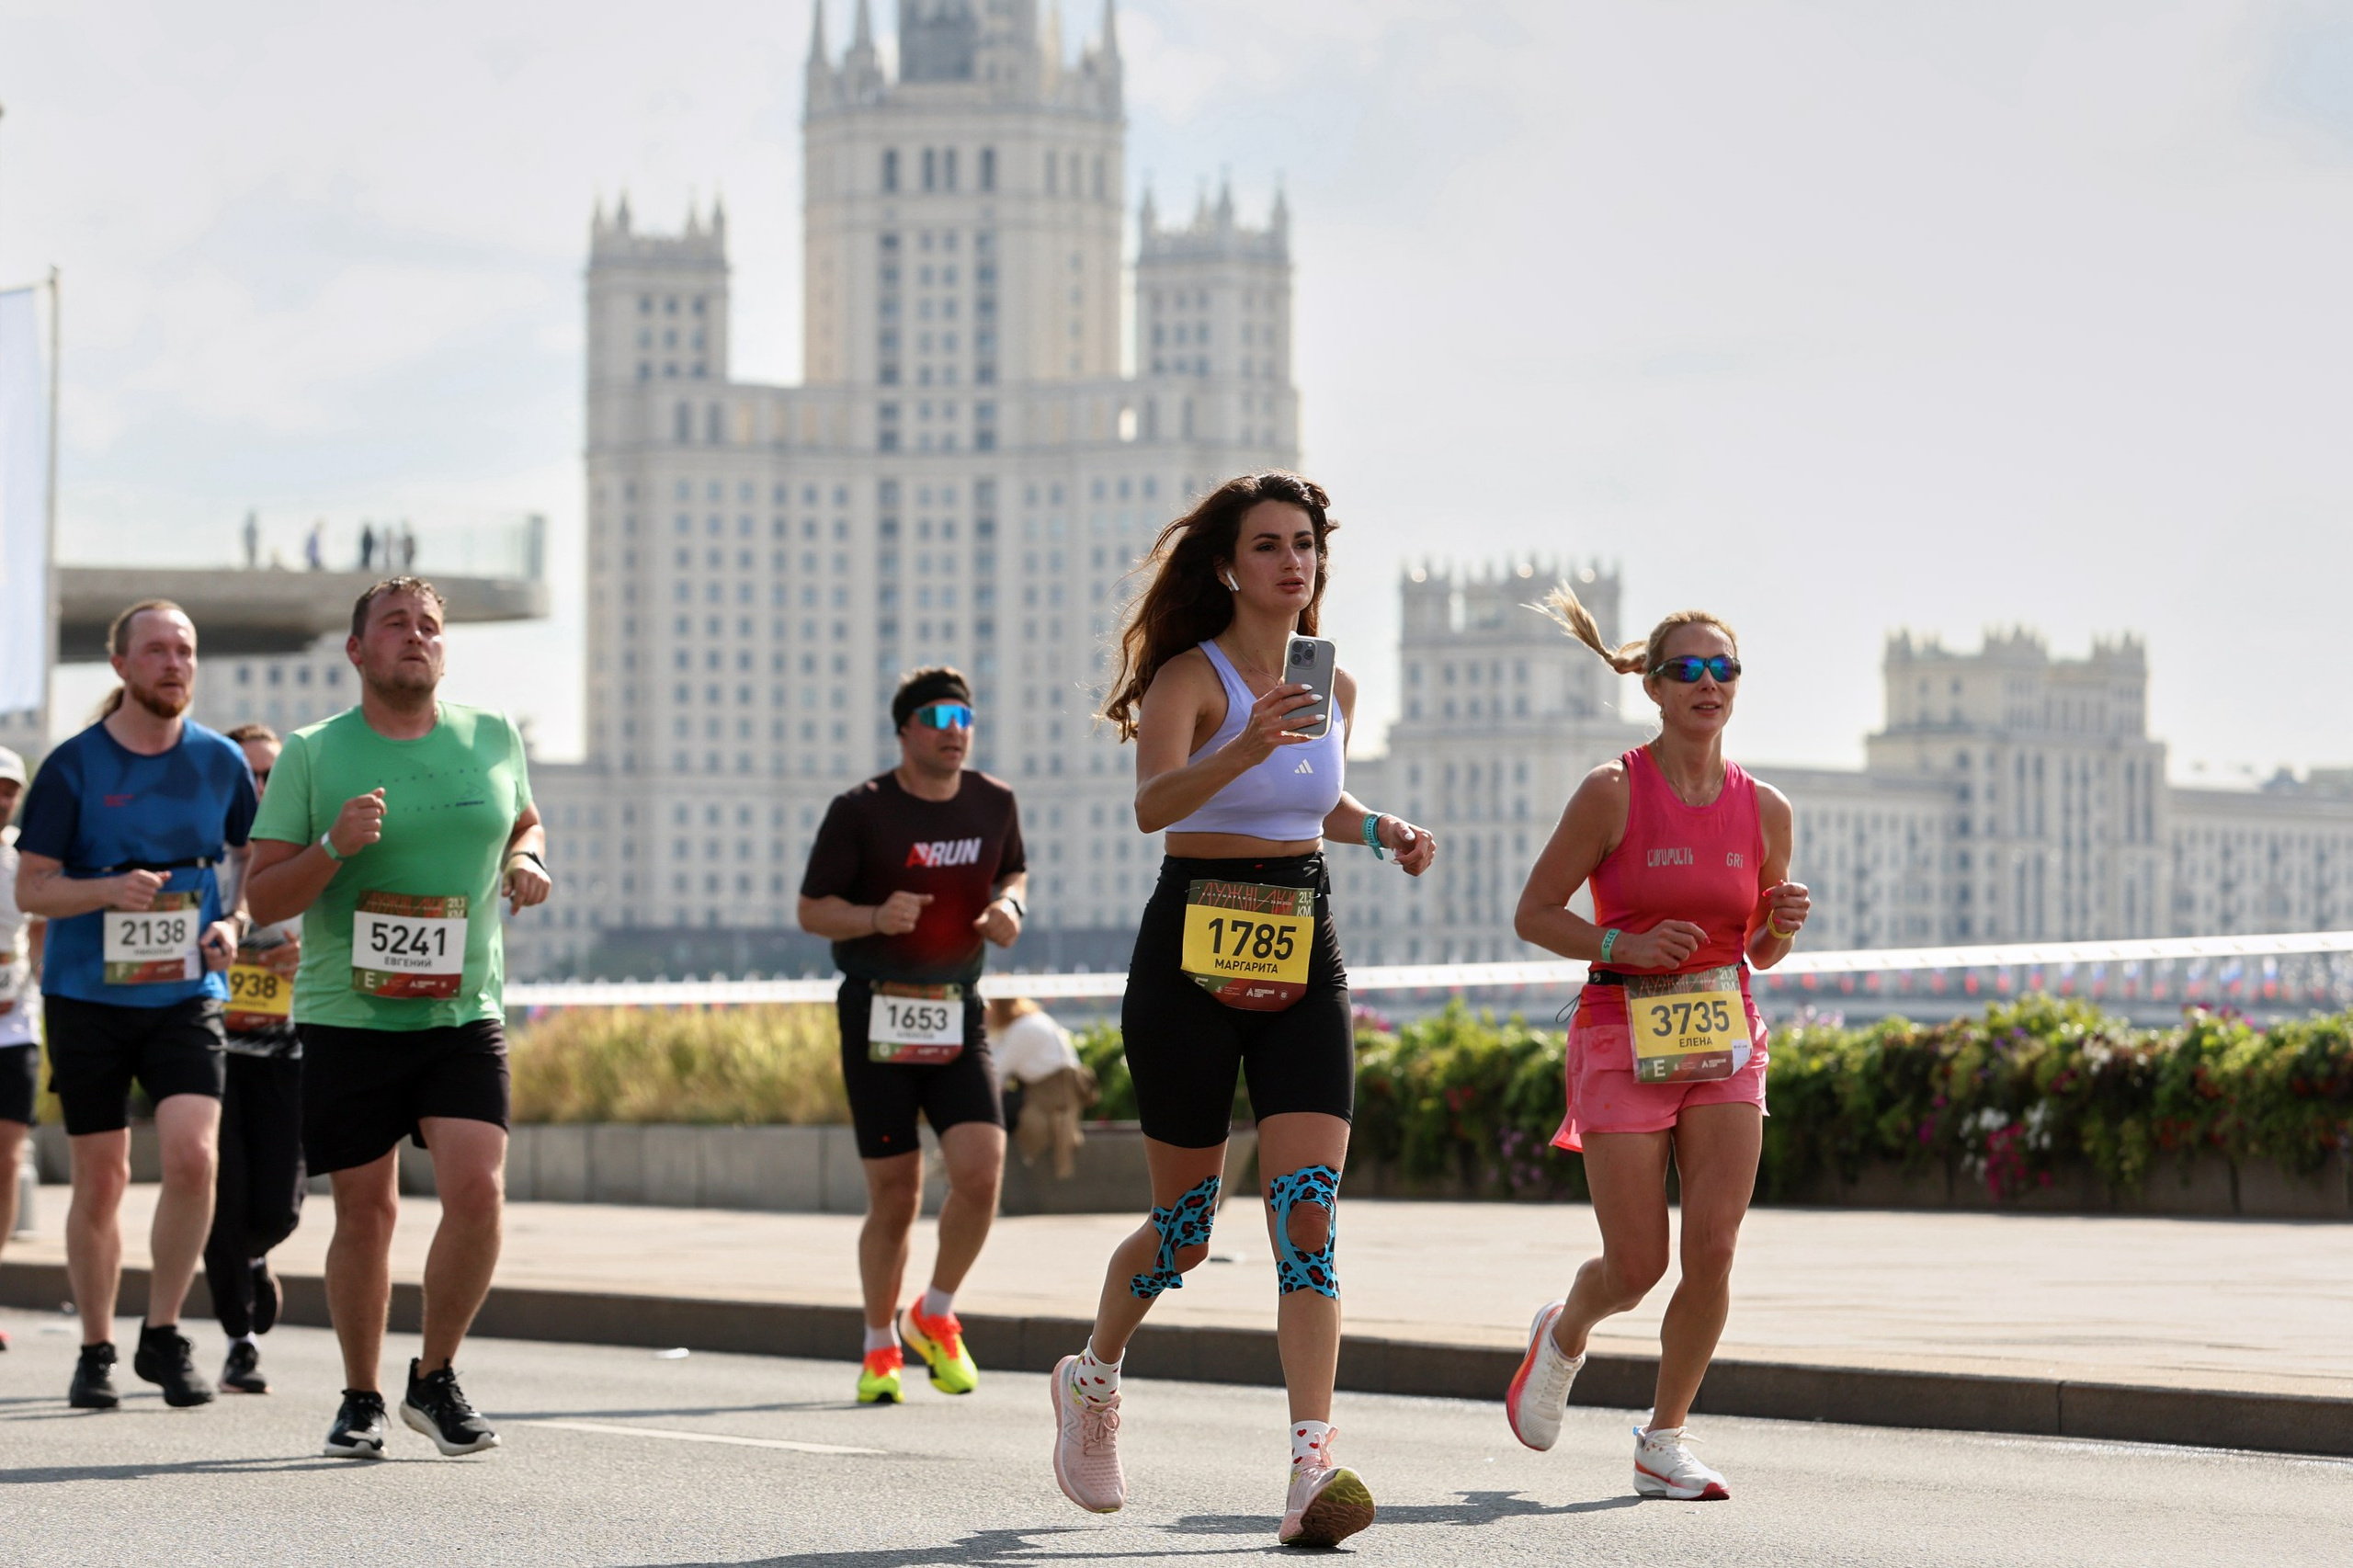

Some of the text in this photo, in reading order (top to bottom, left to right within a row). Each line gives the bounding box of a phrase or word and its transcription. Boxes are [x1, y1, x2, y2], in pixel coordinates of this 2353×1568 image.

[120, 917, 187, 947] 2138
[370, 922, 447, 957] 5241
[1208, 917, 1297, 960] 1785
[384, 956, 433, 968] ЕВГЕНИЙ
[1214, 958, 1279, 974] МАРГАРИТА
[1720, 969, 1734, 982] 21,1
[230, 971, 278, 999] 938
[887, 1004, 948, 1031] 1653
[1651, 1000, 1730, 1037] 3735
[1678, 1037, 1713, 1048] ЕЛЕНА
[1654, 1059, 1666, 1077] E
